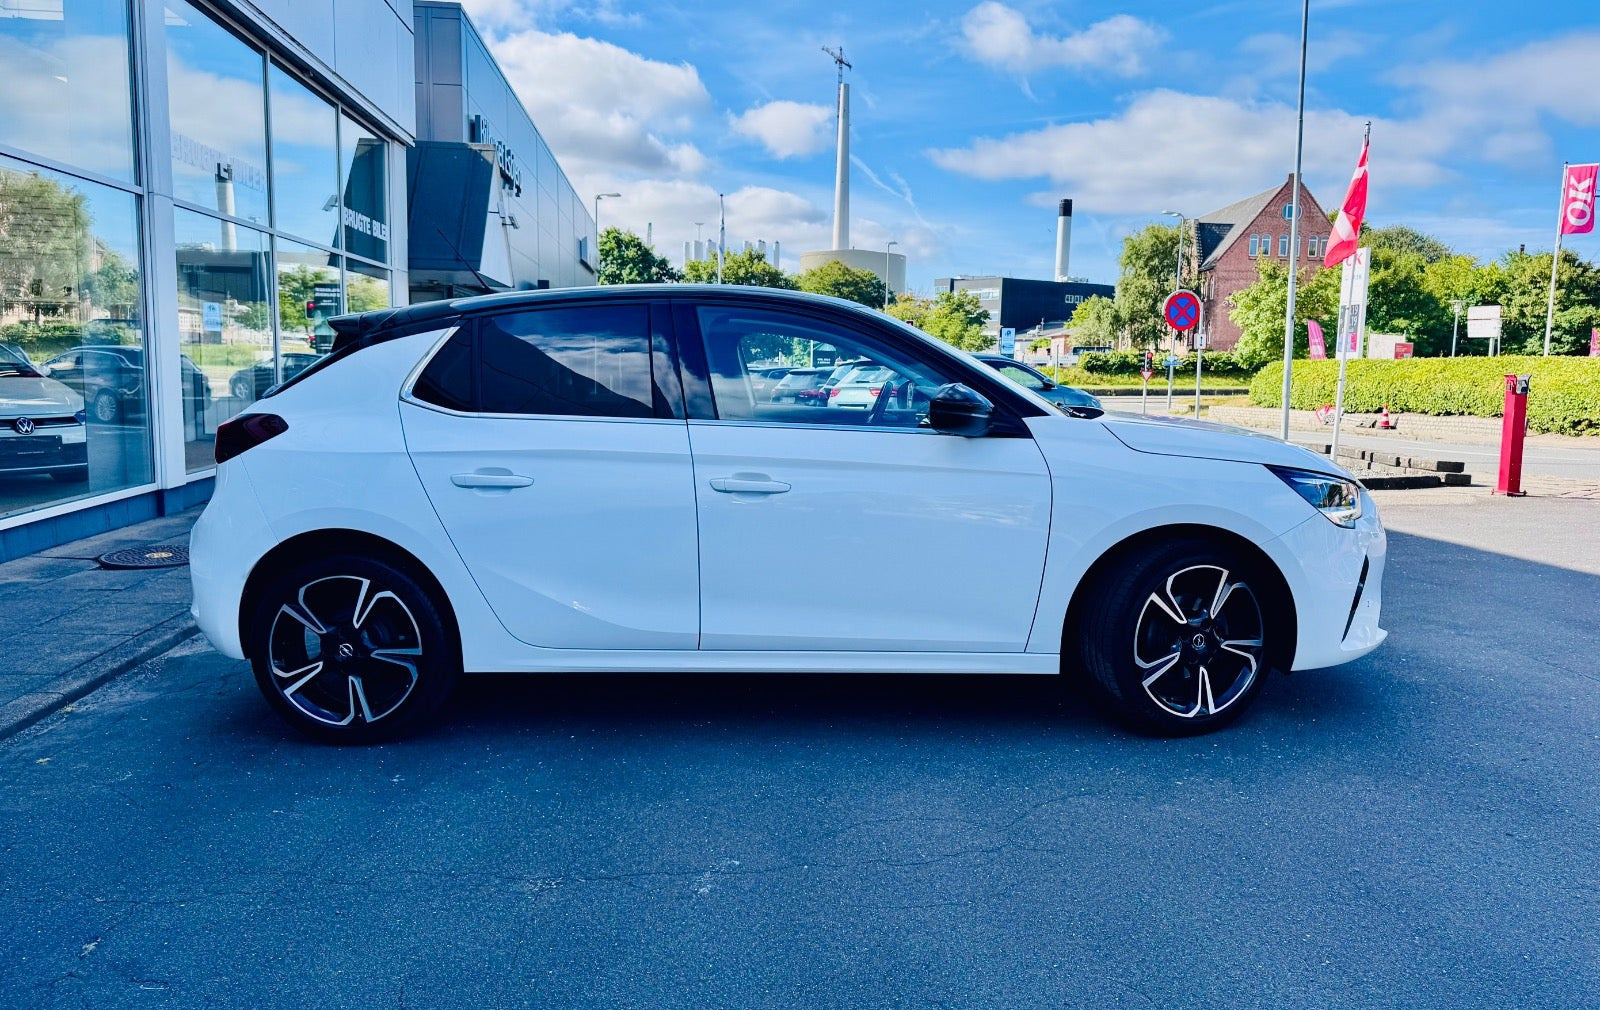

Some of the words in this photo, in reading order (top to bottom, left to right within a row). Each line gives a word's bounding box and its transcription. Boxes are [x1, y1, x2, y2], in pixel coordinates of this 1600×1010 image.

[1567, 175, 1592, 226] OK
[343, 206, 371, 235] BRUGTE
[372, 219, 388, 241] BILE
